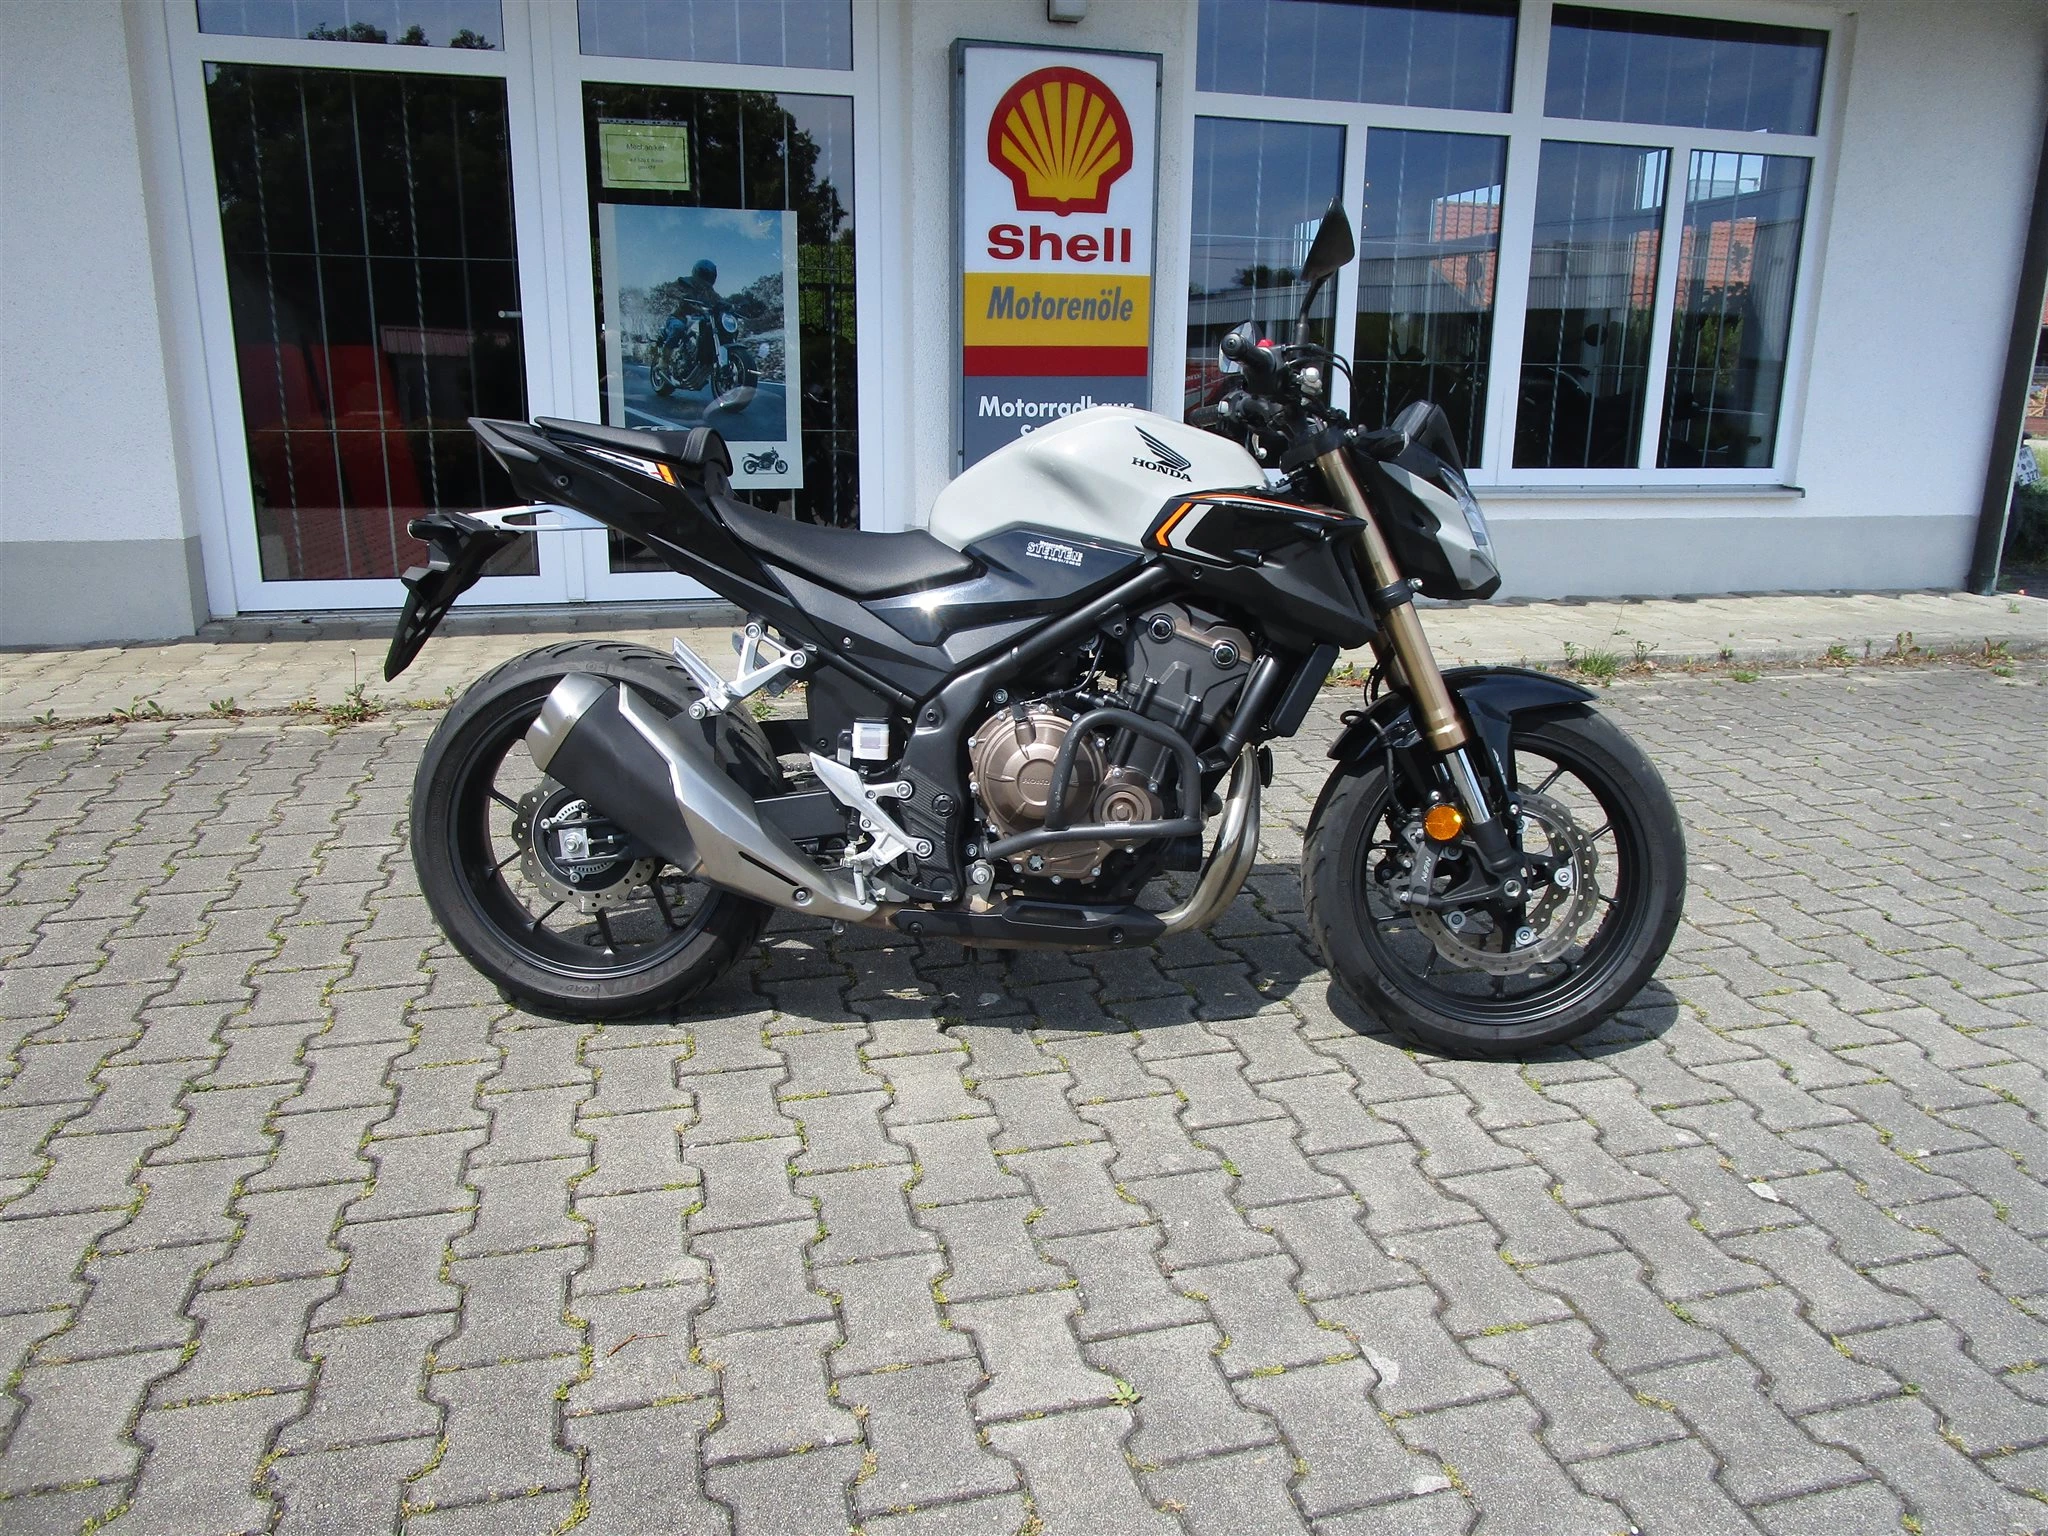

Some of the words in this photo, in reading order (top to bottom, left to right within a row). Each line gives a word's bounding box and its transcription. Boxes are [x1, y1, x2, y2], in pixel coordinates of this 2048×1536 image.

[987, 224, 1132, 263] Shell
[986, 286, 1134, 321] Motorenöle
[978, 395, 1134, 418] Motorradh
[1131, 456, 1193, 483] HONDA
[2025, 469, 2039, 482] 327
[1021, 777, 1051, 786] HOND
